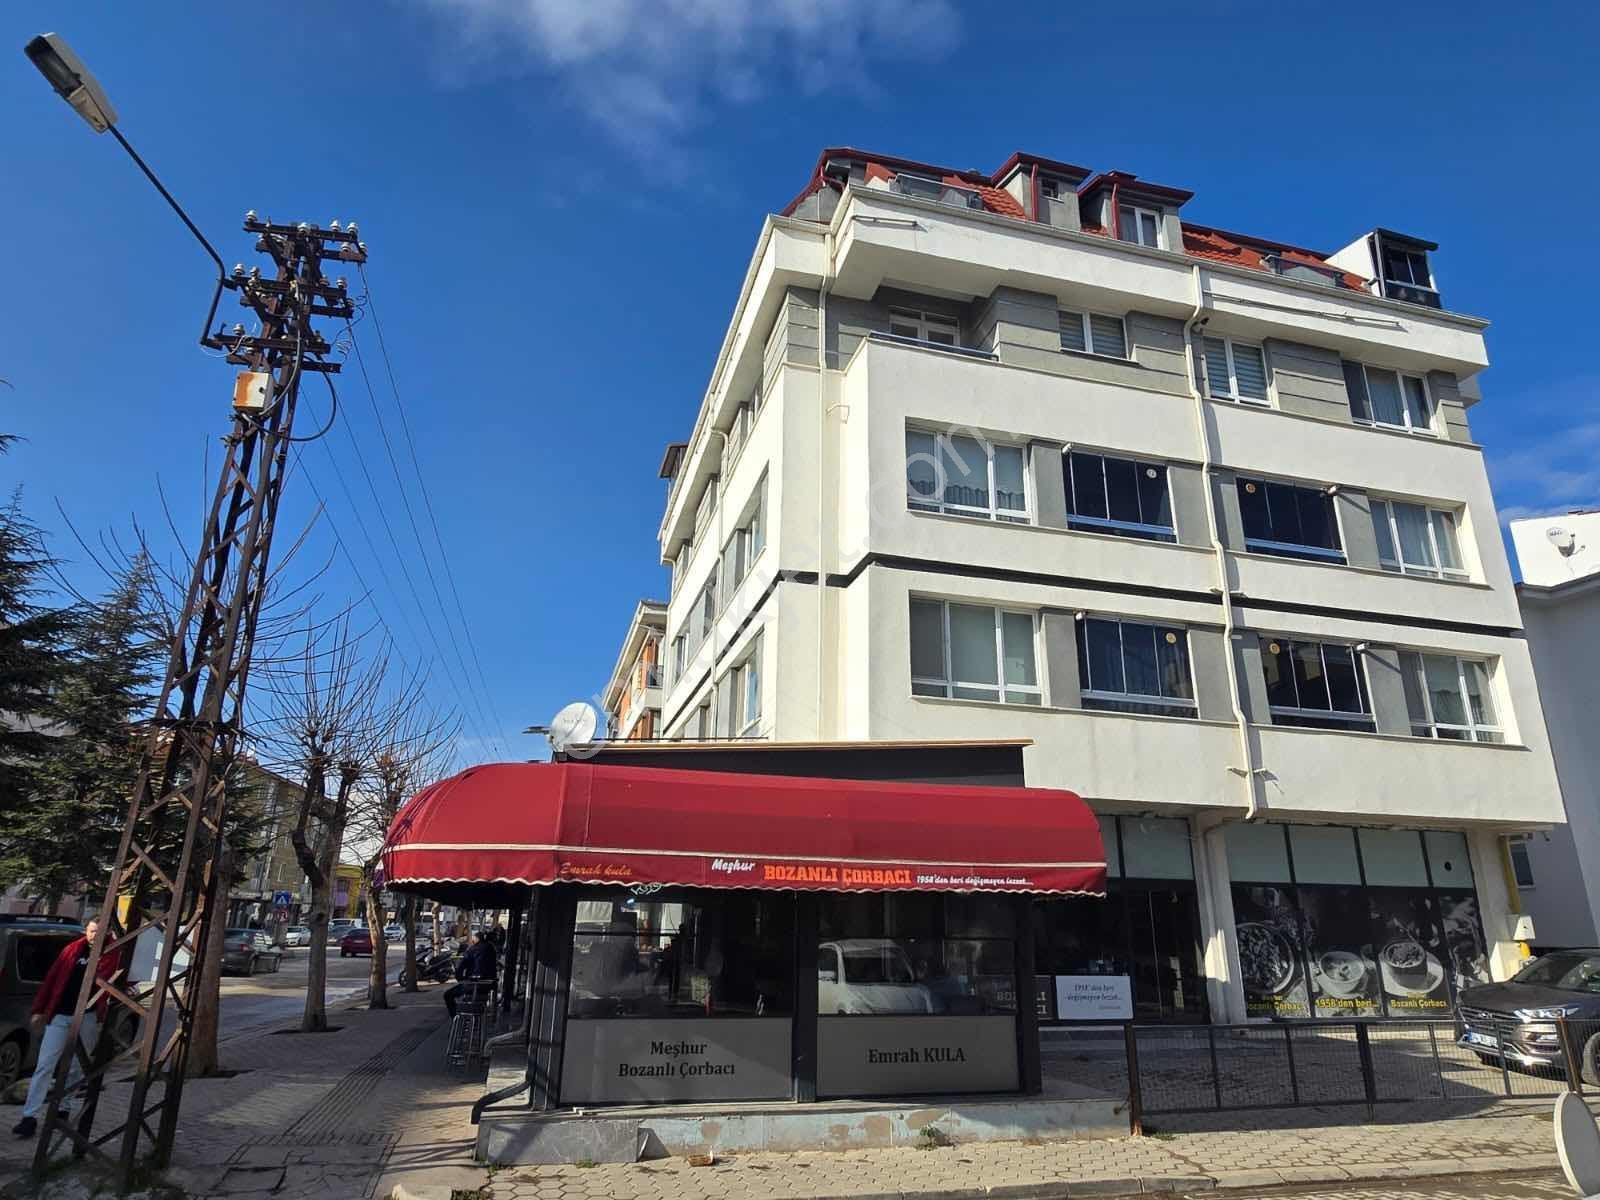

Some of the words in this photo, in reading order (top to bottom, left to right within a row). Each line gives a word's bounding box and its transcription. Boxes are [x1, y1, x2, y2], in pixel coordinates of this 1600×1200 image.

[560, 861, 602, 875] Emrah
[711, 858, 756, 873] Meşhur
[763, 864, 838, 883] BOZANLI
[841, 868, 912, 886] ÇORBACI
[650, 1040, 708, 1058] Meşhur
[868, 1047, 920, 1063] Emrah
[924, 1047, 967, 1063] KULA
[618, 1062, 675, 1077] Bozanlı
[679, 1061, 735, 1079] Çorbacı
